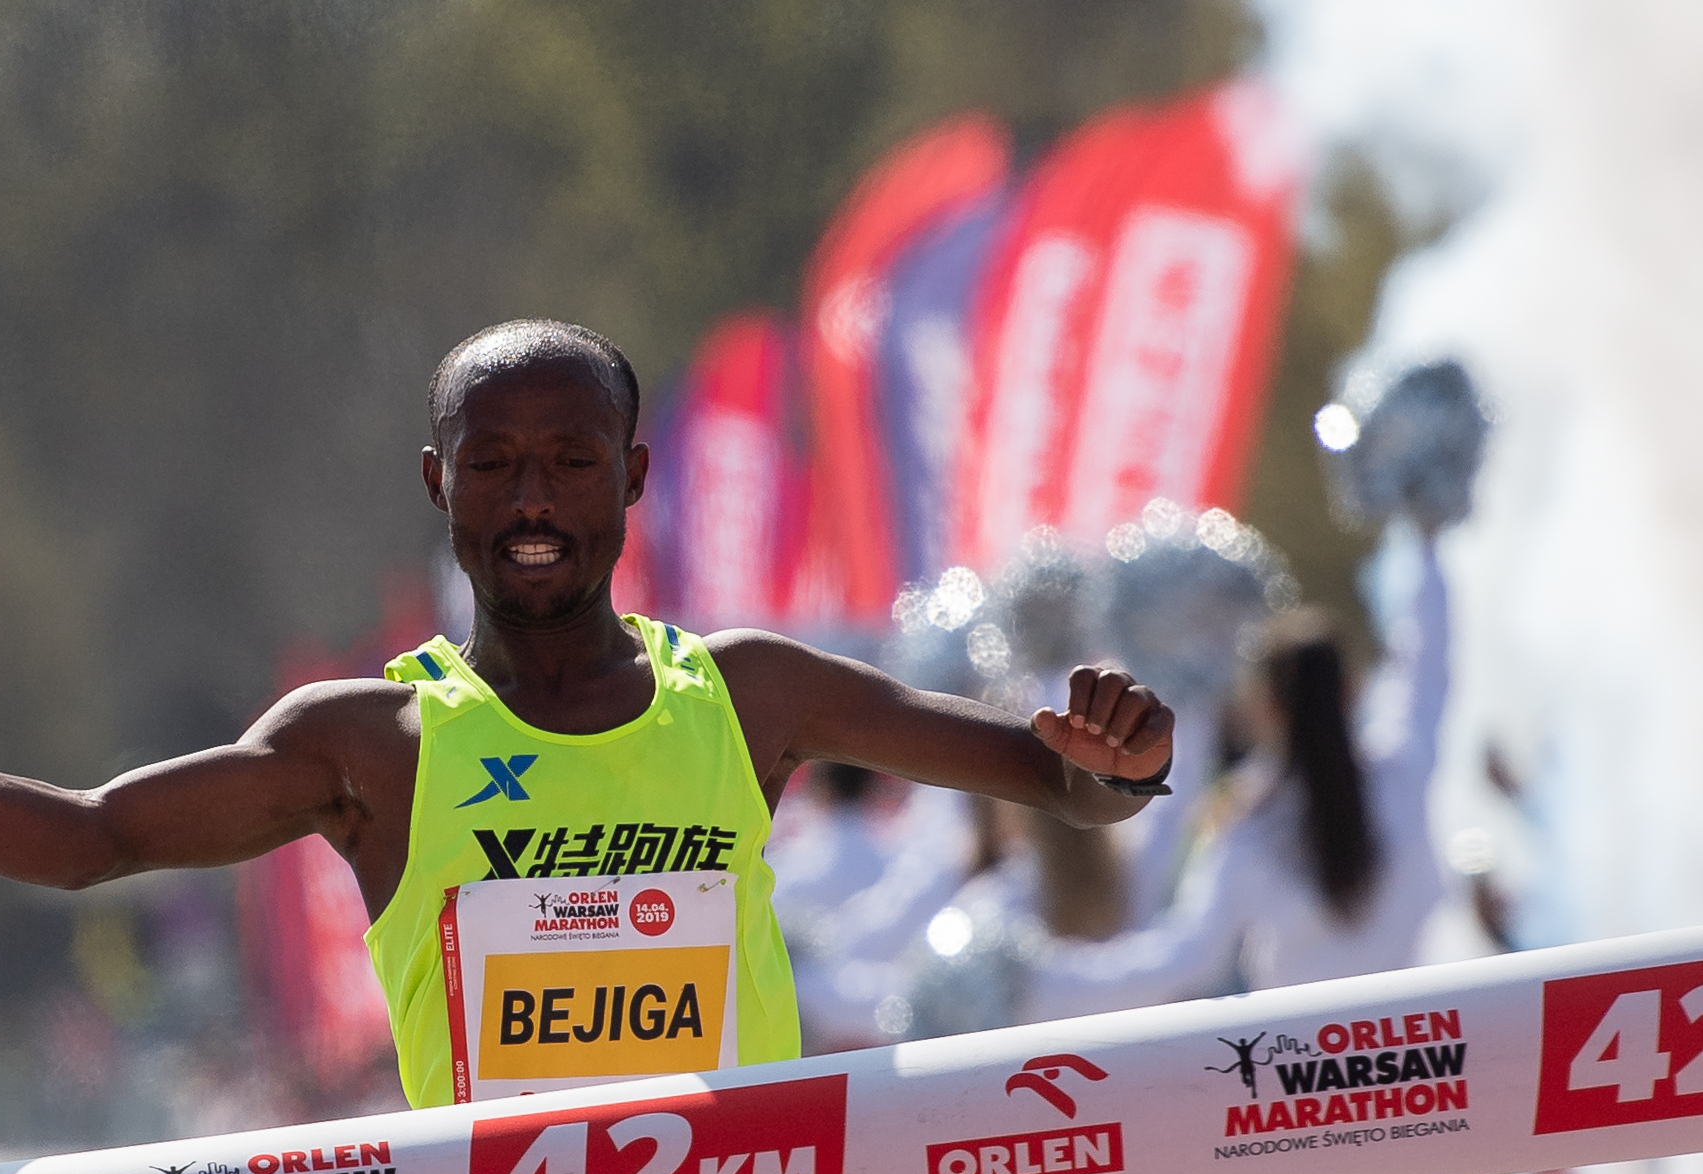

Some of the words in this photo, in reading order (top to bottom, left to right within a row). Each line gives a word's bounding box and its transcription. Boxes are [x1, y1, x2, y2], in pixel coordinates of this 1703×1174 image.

[553, 904, 619, 918] WARSAW
[568, 891, 618, 904] ORLEN
[534, 917, 619, 931] MARATHON
[636, 912, 669, 924] 2019
[443, 923, 455, 952] ELITE
[500, 983, 703, 1045] BEJIGA
[1317, 1009, 1462, 1054] ORLEN
[1276, 1043, 1467, 1095] WARSAW
[1225, 1080, 1468, 1137] MARATHON
[1214, 1136, 1318, 1159] NARODOWE
[1322, 1128, 1386, 1147] ŚWIĘTO
[1390, 1118, 1470, 1140] BIEGANIA
